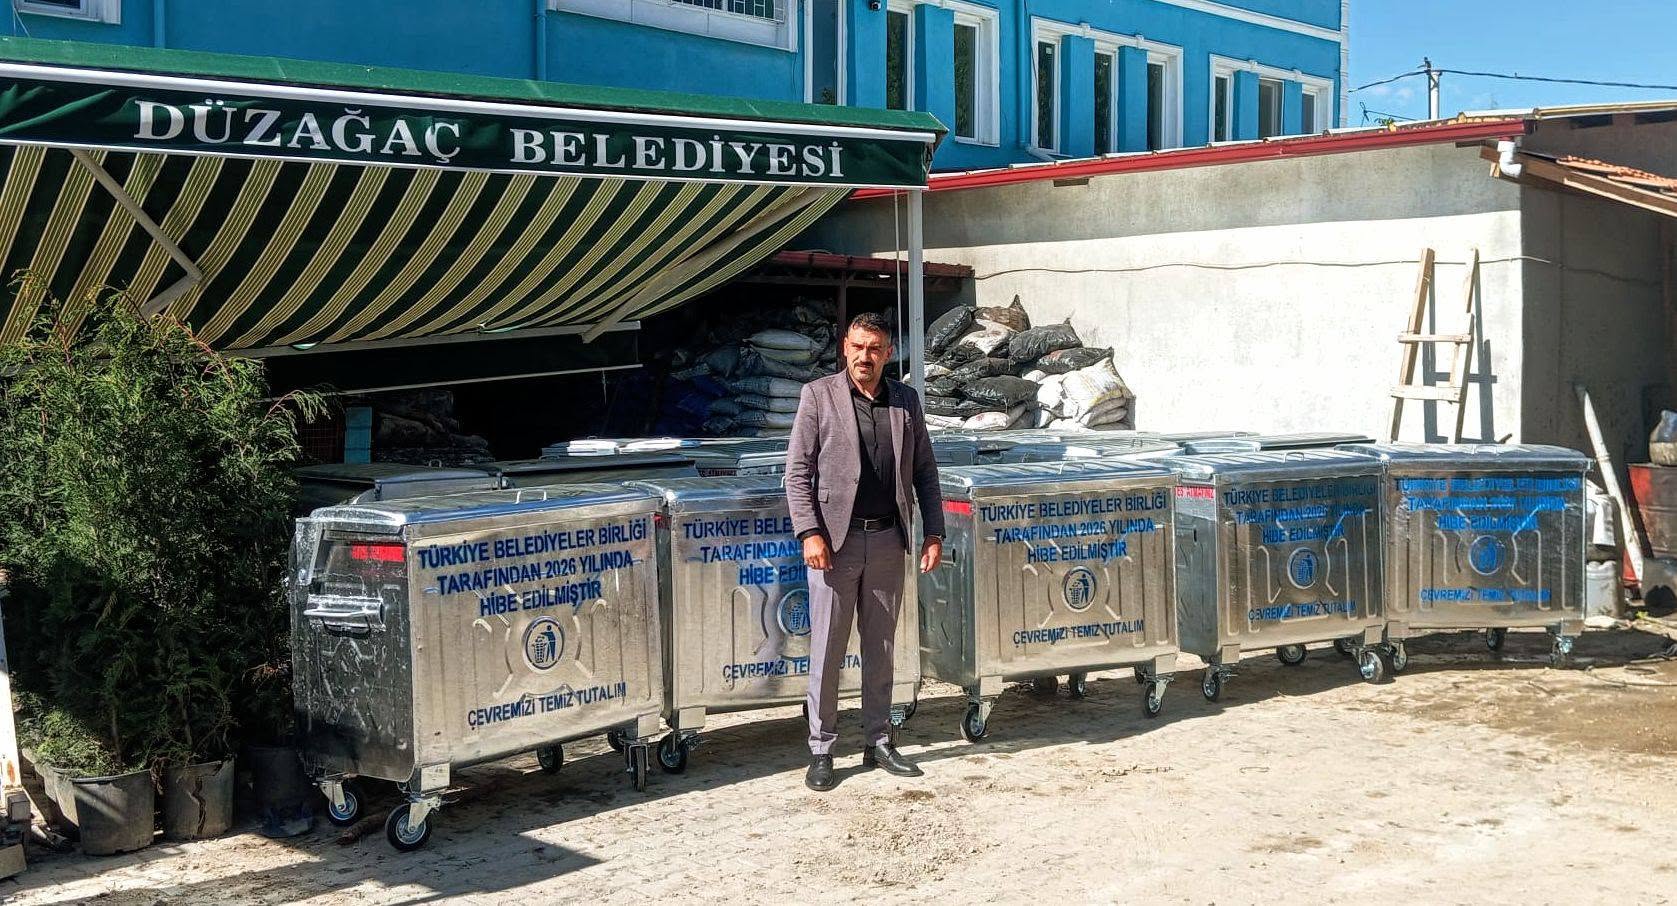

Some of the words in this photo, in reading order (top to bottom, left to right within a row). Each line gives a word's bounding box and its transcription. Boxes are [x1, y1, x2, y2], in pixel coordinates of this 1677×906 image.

[134, 98, 460, 163] DÜZAĞAÇ
[510, 134, 844, 177] BELEDİYESİ
[980, 501, 1035, 522] TÜRKİYE
[1039, 497, 1122, 518] BELEDİYELER
[1126, 492, 1167, 511] BİRLİĞİ
[683, 516, 748, 539] TÜRKİYE
[994, 523, 1077, 545] TARAFINDAN
[1080, 521, 1106, 537] 2026
[1110, 517, 1155, 535] YILINDA
[418, 540, 490, 569] TÜRKİYE
[494, 529, 595, 559] BELEDİYELER
[600, 518, 647, 545] BİRLİĞİ
[700, 540, 799, 564] TARAFINDAN
[1028, 544, 1058, 564] HİBE
[1061, 538, 1128, 562] EDİLMİŞTİR
[437, 565, 541, 595] TARAFINDAN
[546, 558, 576, 579] 2026
[579, 550, 633, 574] YILINDA
[739, 564, 775, 585] HİBE
[480, 591, 518, 617] HİBE
[522, 577, 602, 610] EDİLMİŞTİR
[1102, 619, 1144, 636] TUTALIM
[576, 682, 627, 706] TUTALIM
